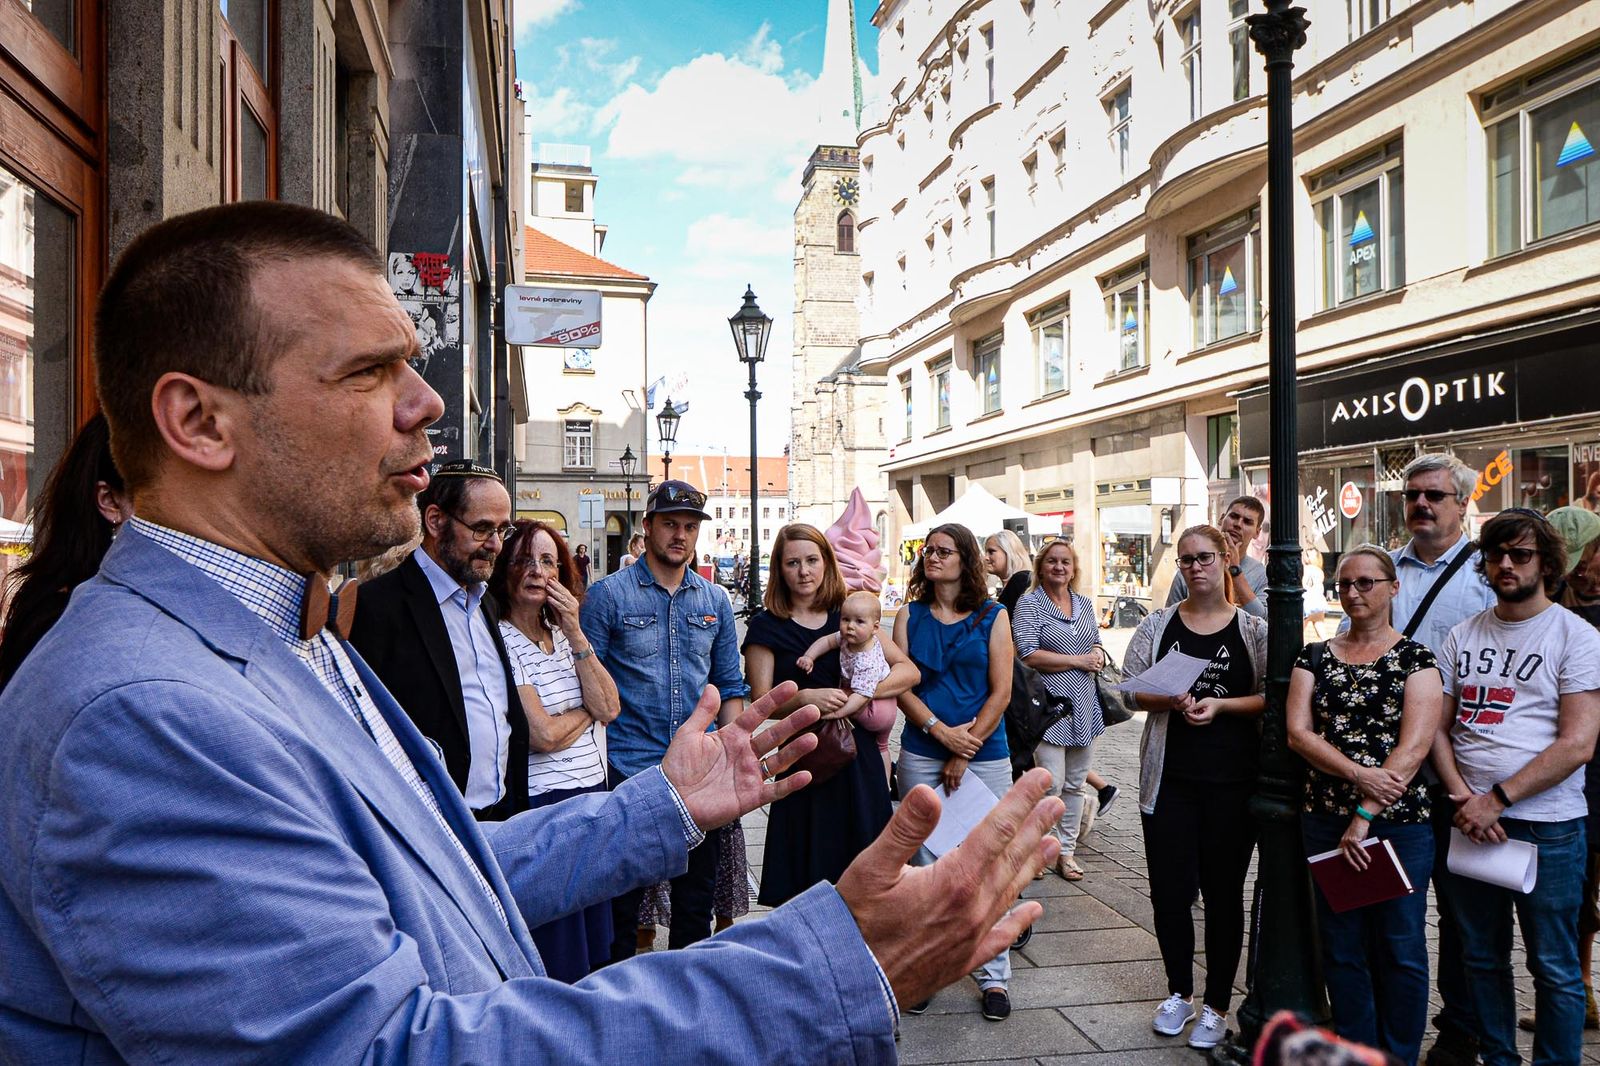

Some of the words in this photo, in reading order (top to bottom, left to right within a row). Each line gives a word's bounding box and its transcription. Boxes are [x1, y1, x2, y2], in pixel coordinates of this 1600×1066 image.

[1349, 243, 1376, 266] APEX
[1206, 661, 1230, 672] pend
[1203, 670, 1221, 680] lives
[1195, 681, 1211, 691] you
